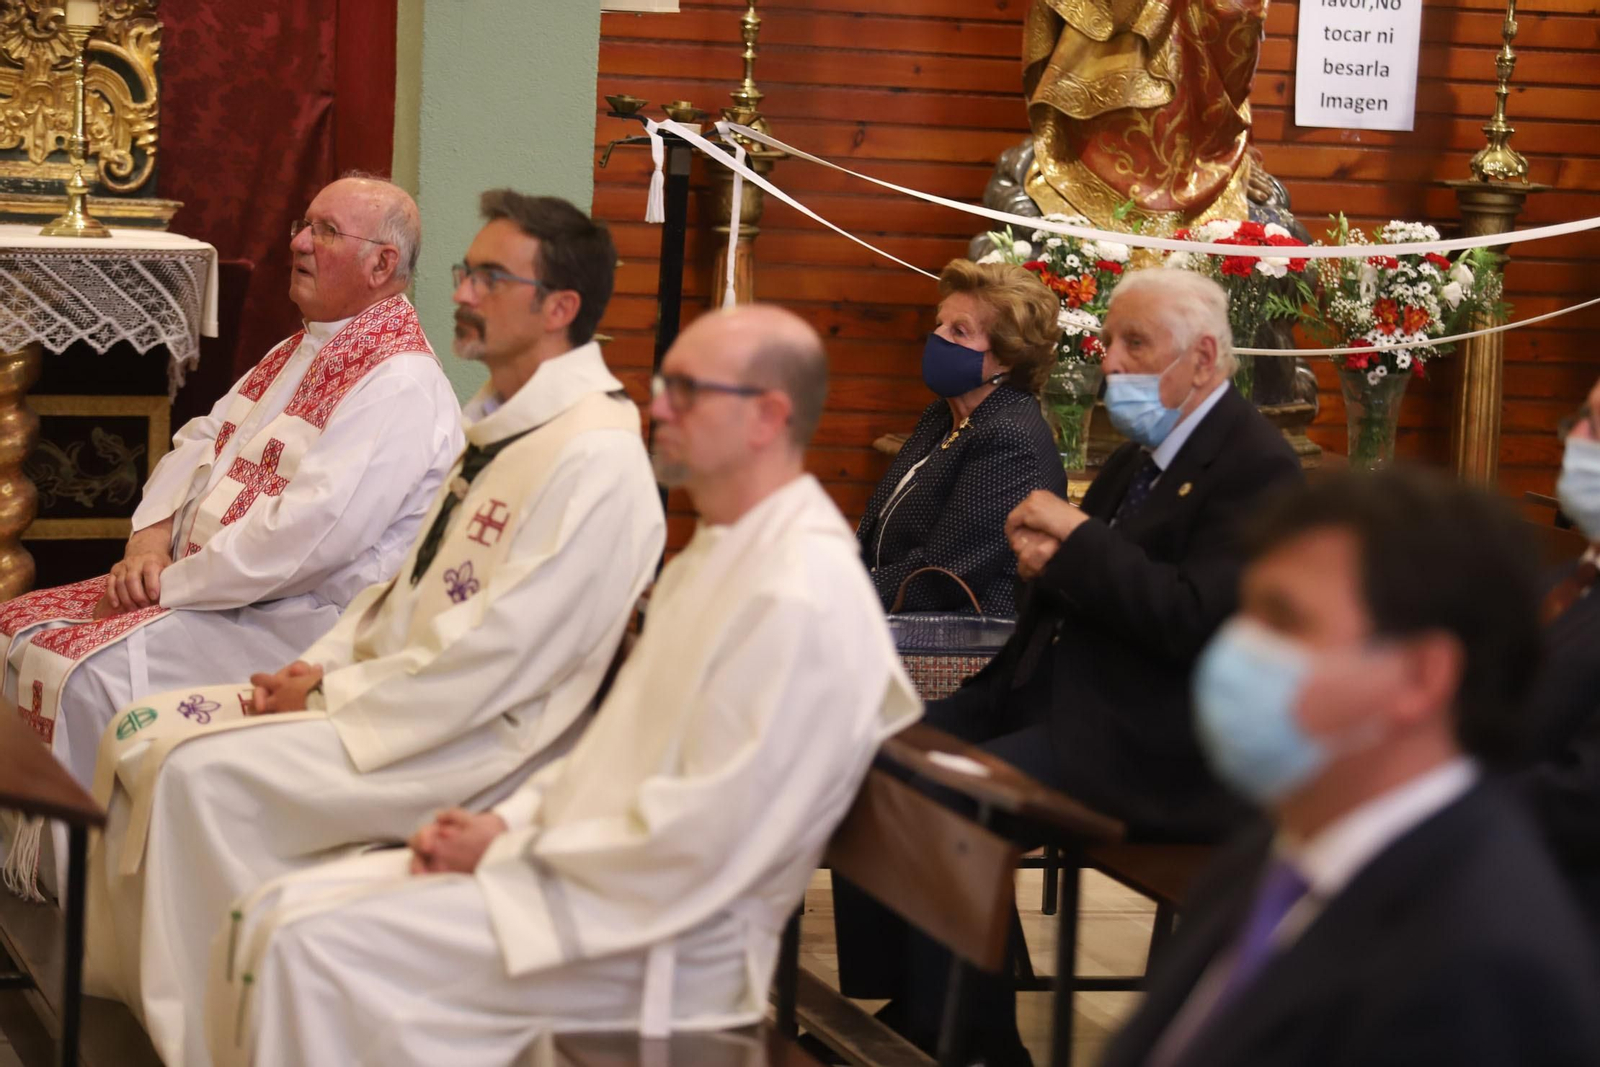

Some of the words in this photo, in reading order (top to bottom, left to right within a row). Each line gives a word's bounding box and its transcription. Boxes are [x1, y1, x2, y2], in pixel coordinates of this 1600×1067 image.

[1323, 26, 1371, 43] tocar
[1377, 28, 1394, 44] ni
[1323, 58, 1390, 77] besarla
[1320, 92, 1388, 114] Imagen
